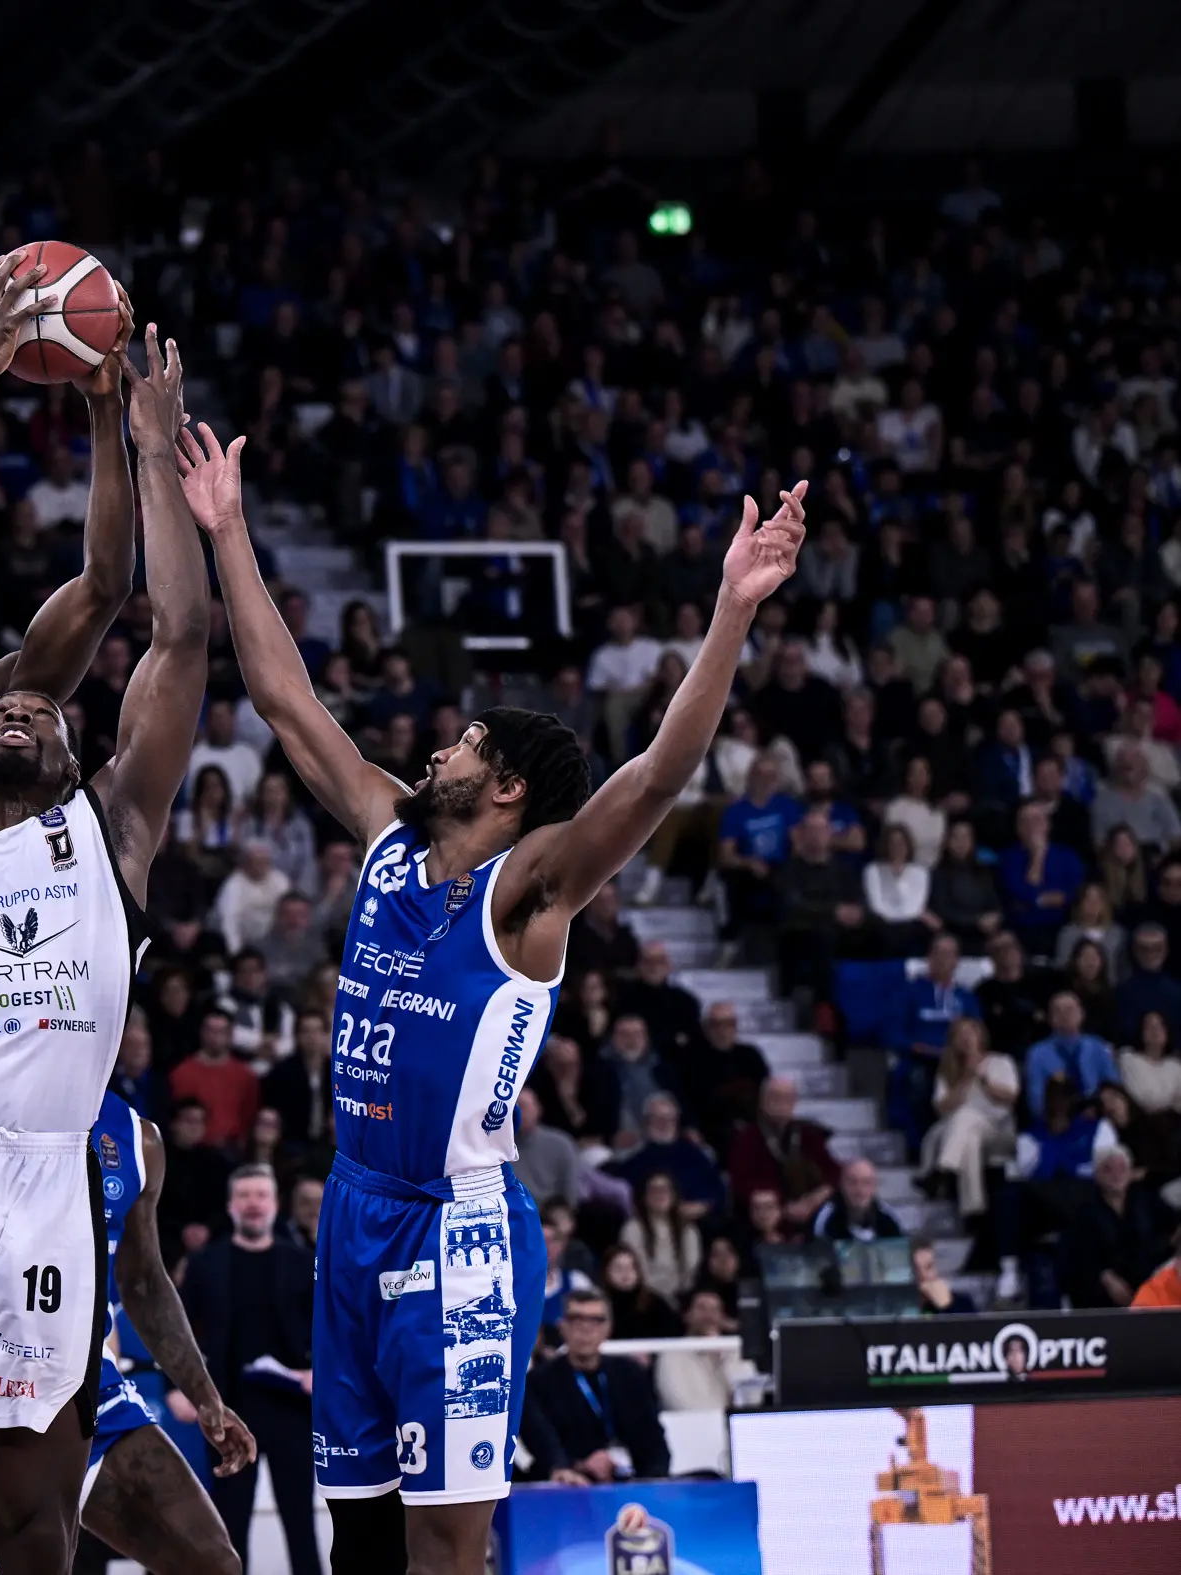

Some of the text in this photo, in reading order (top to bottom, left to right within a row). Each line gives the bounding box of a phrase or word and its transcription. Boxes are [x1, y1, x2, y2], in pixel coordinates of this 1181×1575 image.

[45, 883, 79, 900] ASTM
[451, 888, 469, 896] LBA
[359, 912, 375, 928] errea
[50, 1019, 96, 1033] SYNERGIE
[494, 997, 535, 1101] GERMANI
[23, 1265, 62, 1313] 19
[1, 1340, 54, 1359] RETELIT
